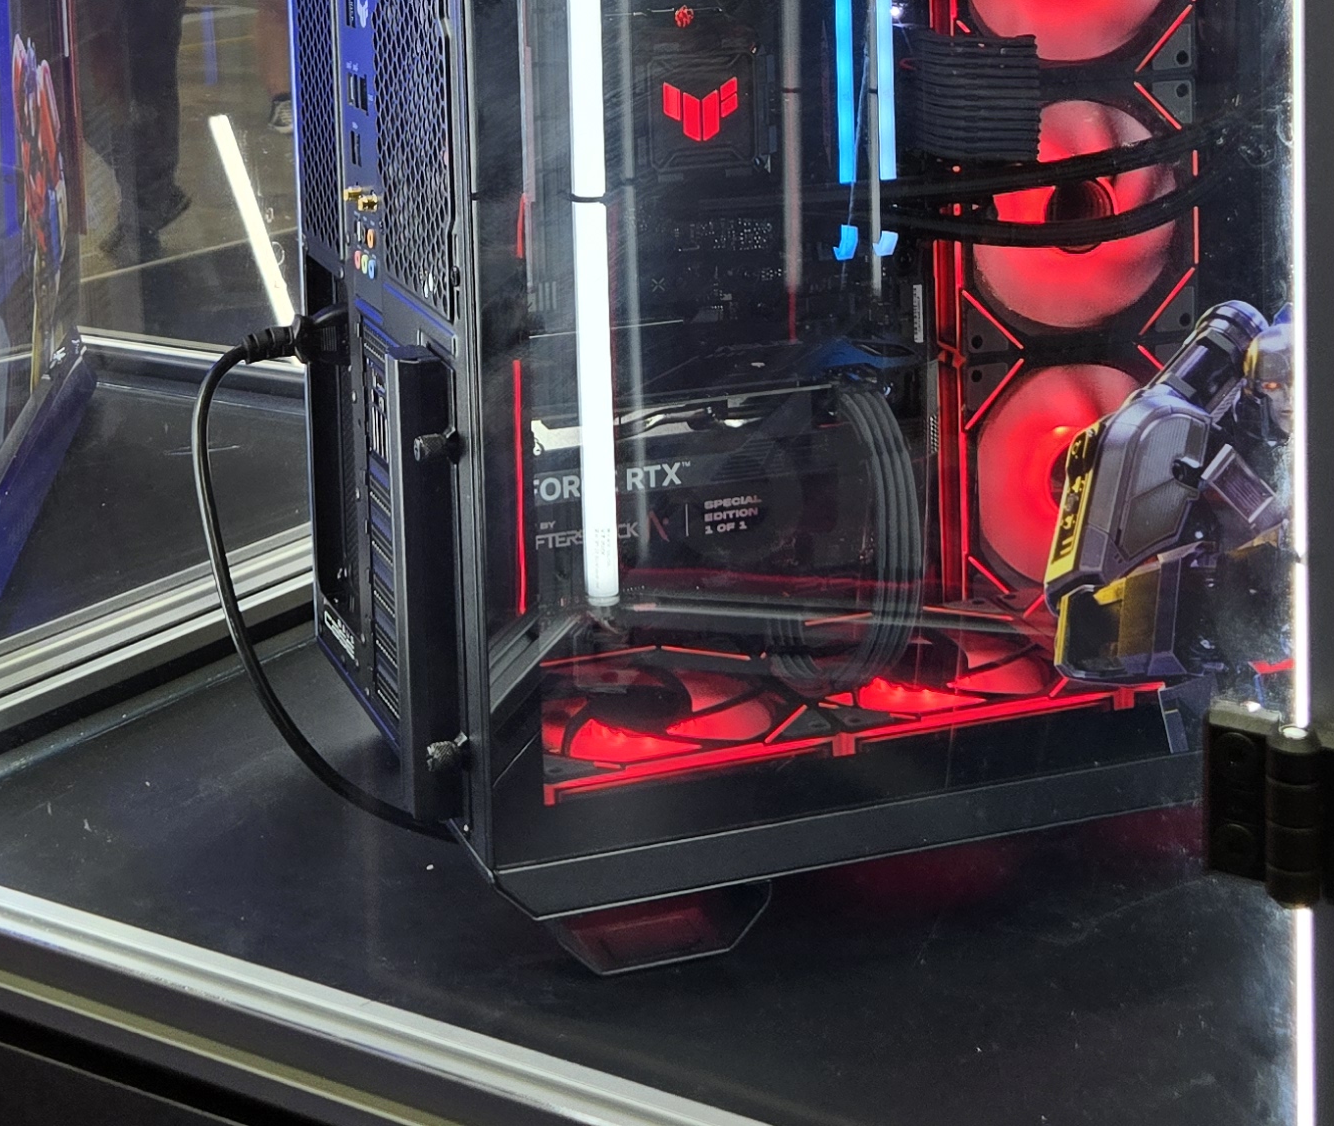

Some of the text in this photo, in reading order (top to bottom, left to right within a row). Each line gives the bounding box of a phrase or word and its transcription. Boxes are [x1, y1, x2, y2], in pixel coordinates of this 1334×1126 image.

[704, 496, 763, 511] SPECIAL
[704, 507, 759, 523] EDITION
[540, 520, 556, 530] BY
[705, 521, 748, 535] 1 OF 1
